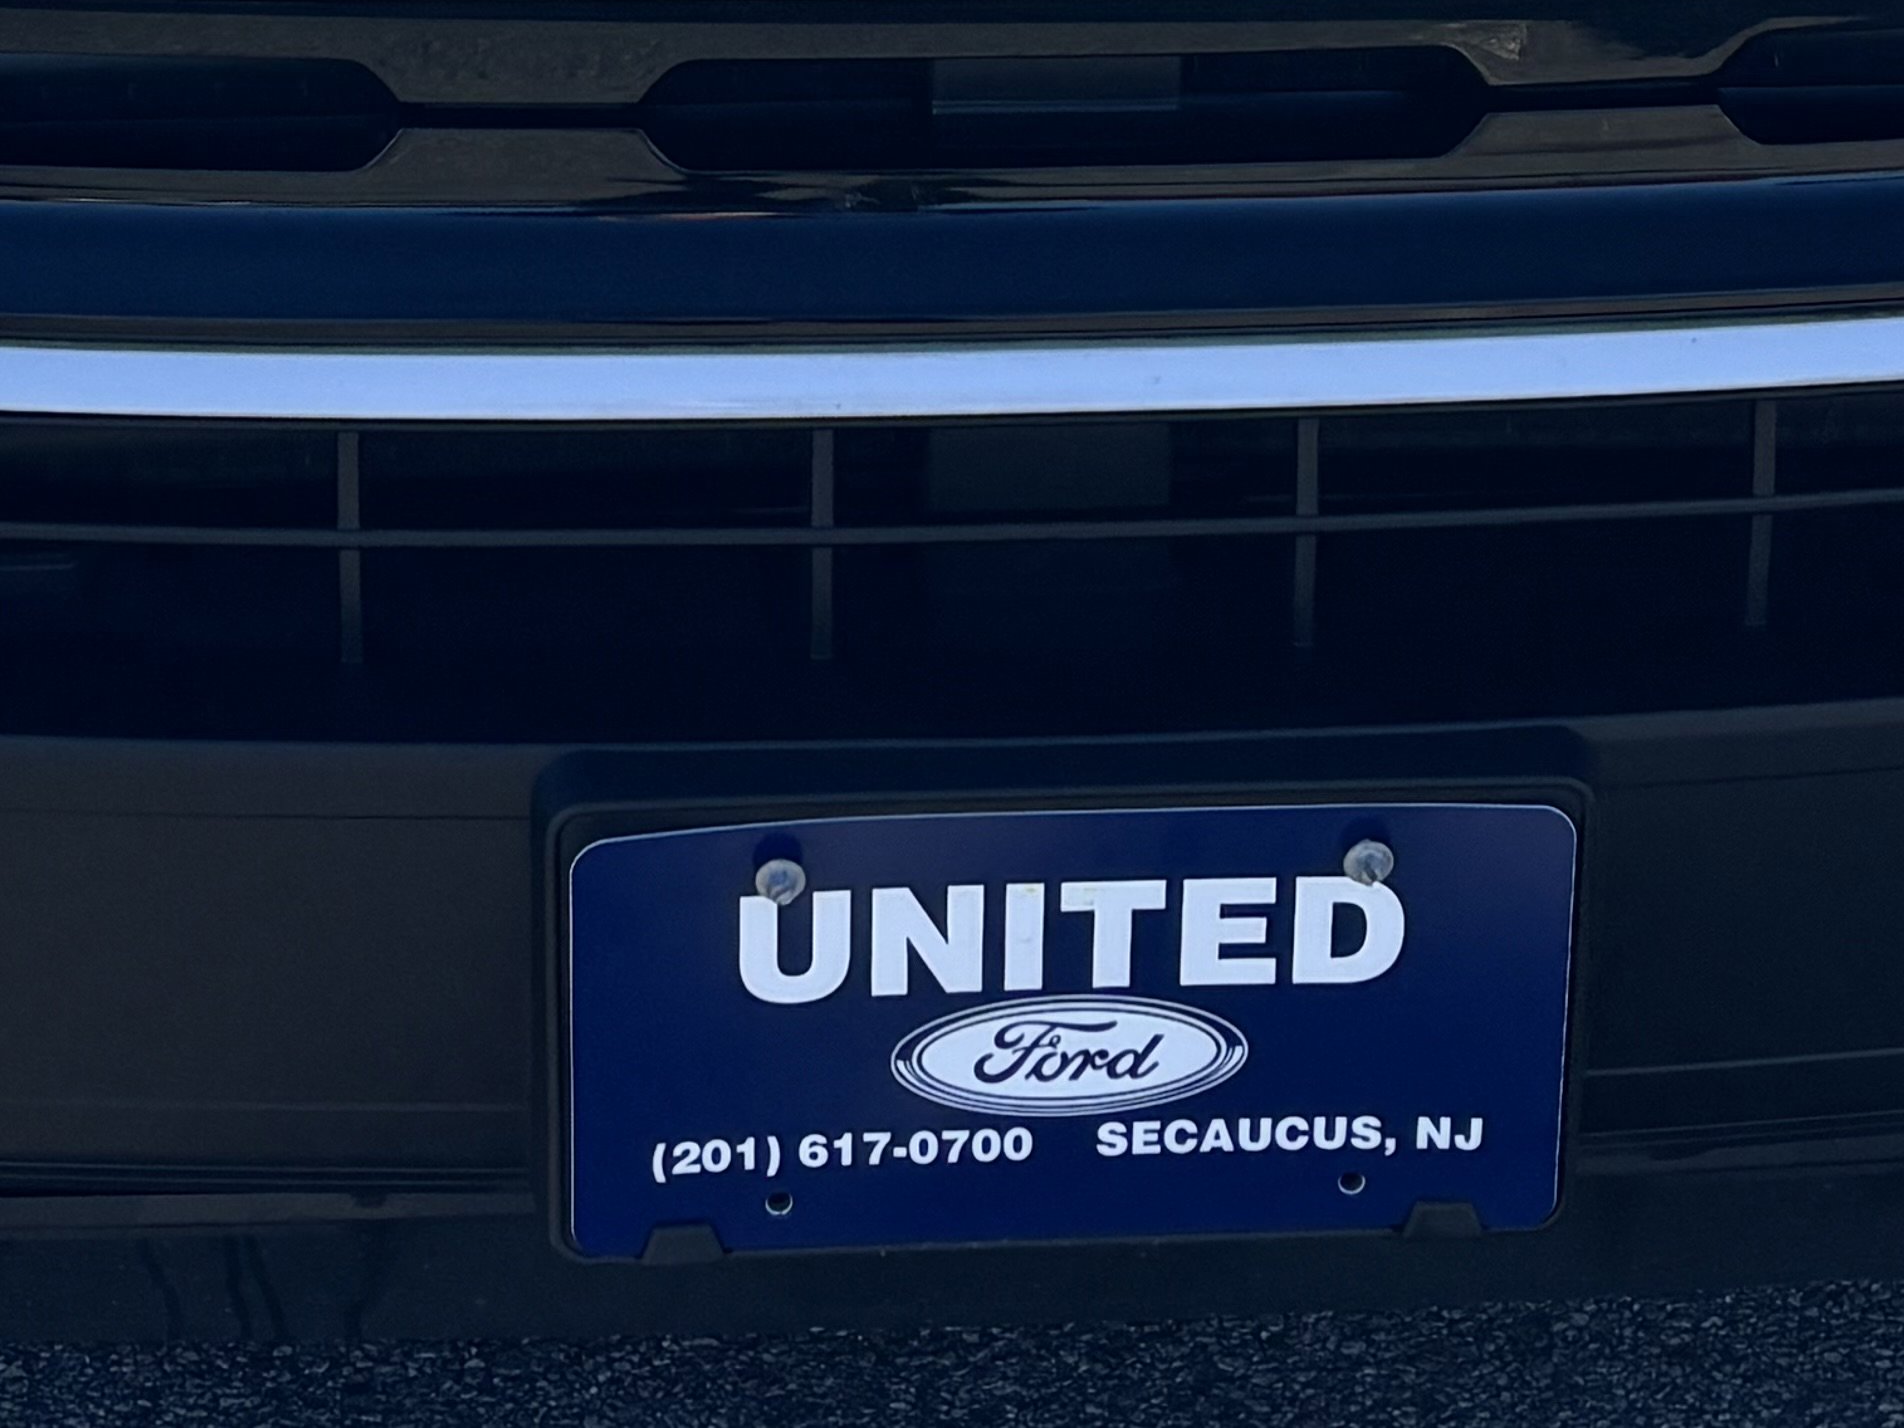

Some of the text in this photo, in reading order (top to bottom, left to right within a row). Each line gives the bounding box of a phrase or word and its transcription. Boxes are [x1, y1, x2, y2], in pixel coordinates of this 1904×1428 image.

[738, 876, 1406, 1004] UNITED
[973, 1019, 1165, 1085] Ford
[651, 1115, 1484, 1183] (201) 617-0700 SECAUCUS, NJ
